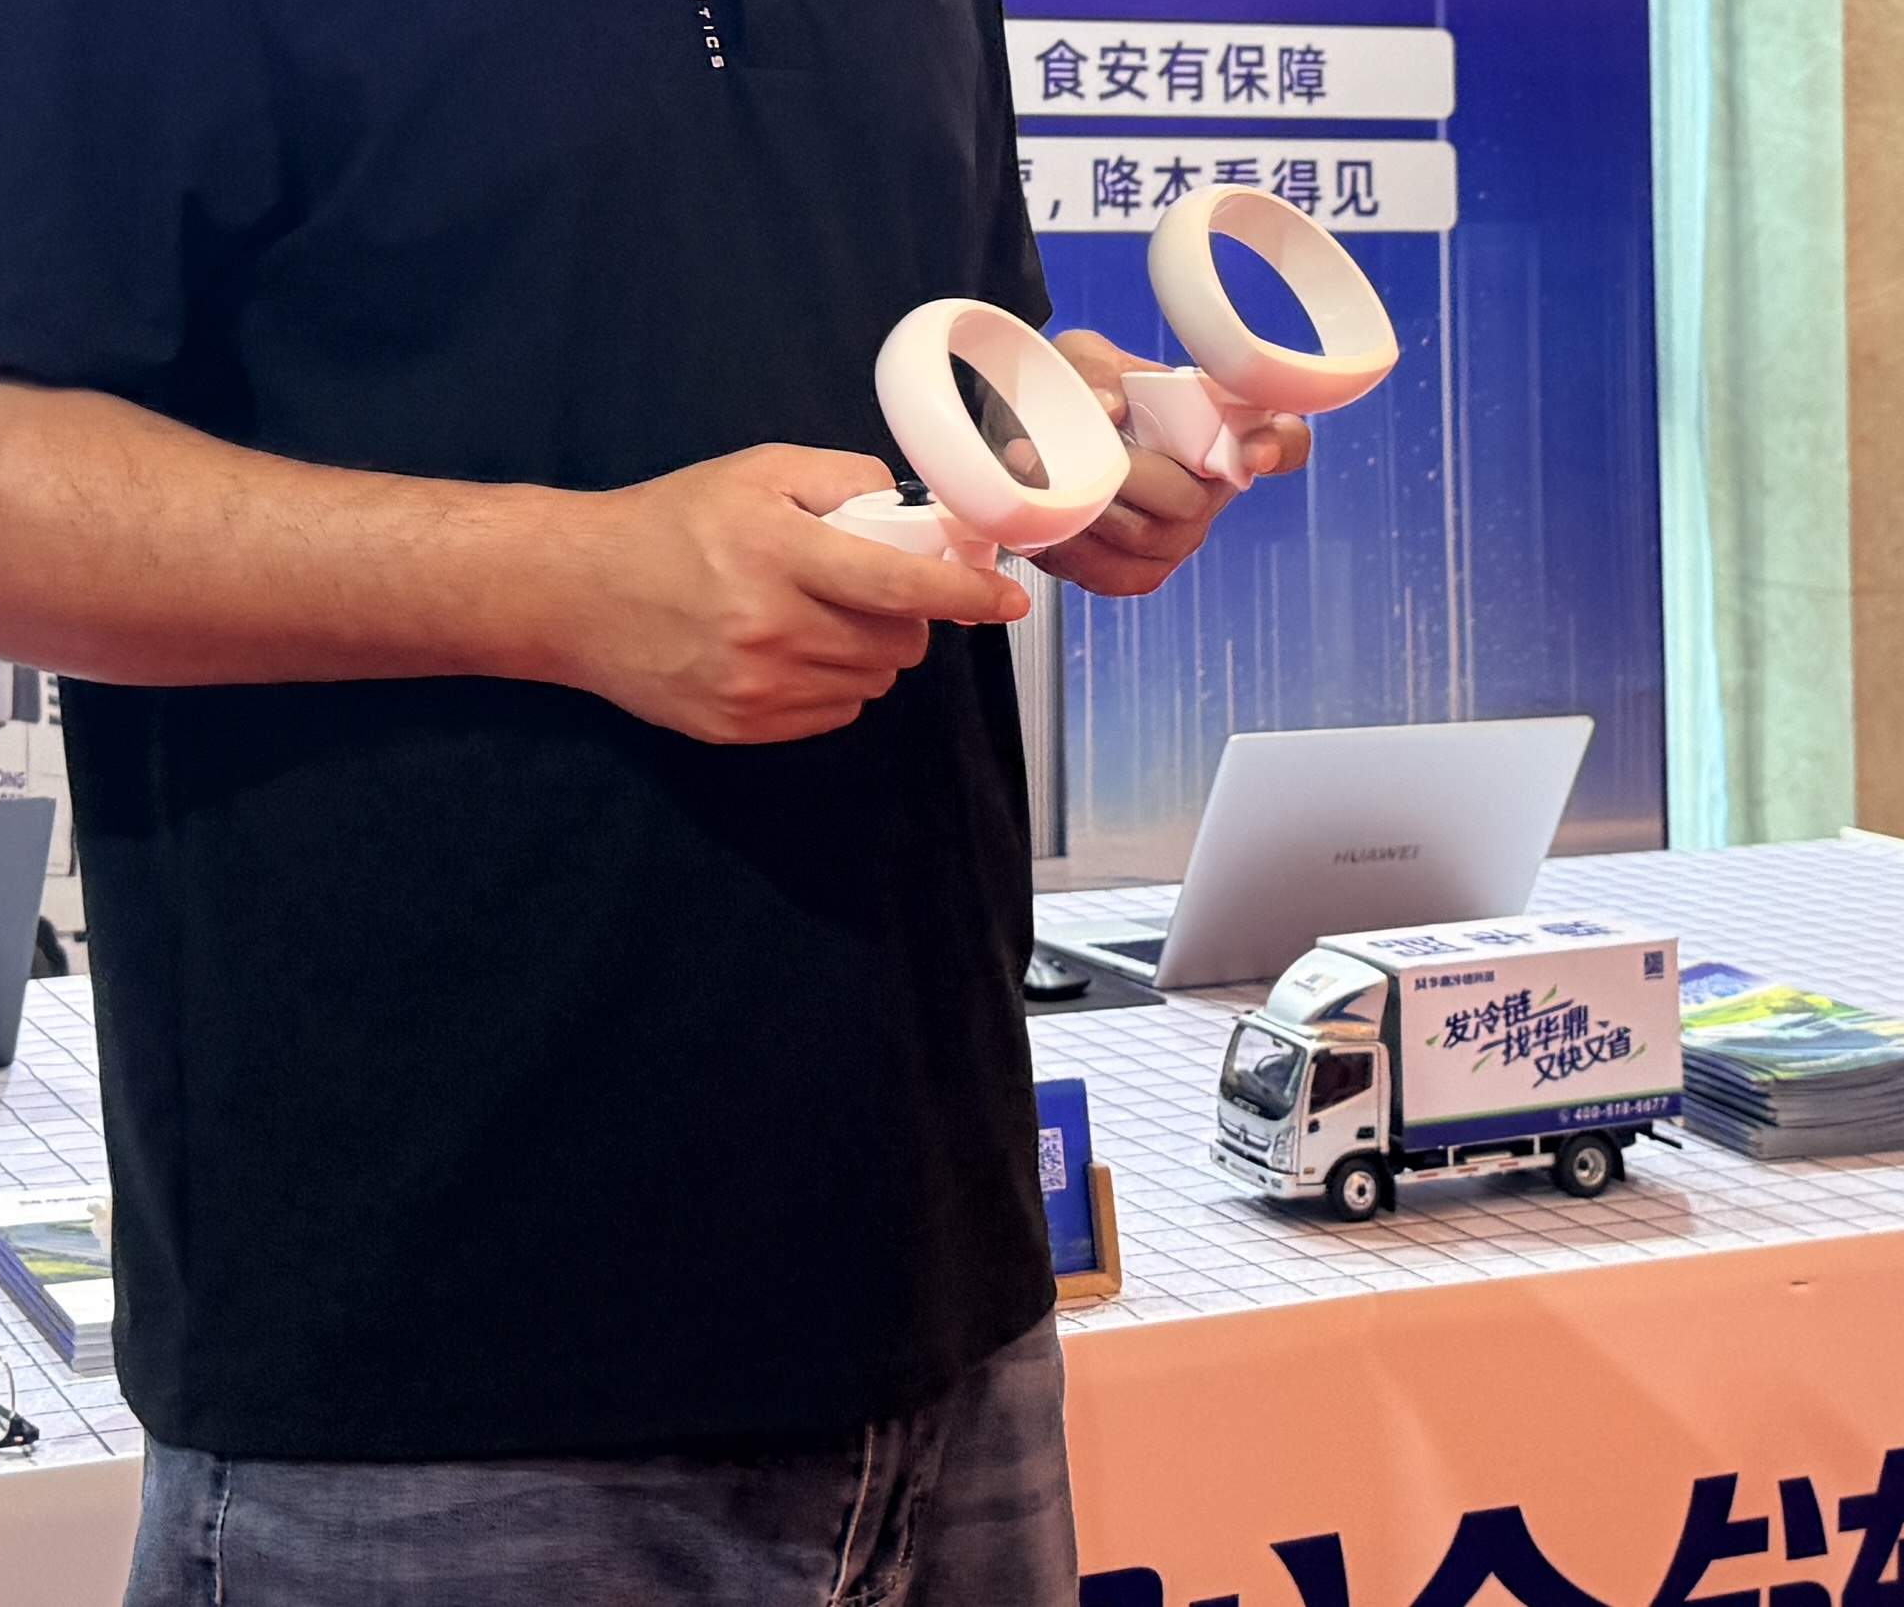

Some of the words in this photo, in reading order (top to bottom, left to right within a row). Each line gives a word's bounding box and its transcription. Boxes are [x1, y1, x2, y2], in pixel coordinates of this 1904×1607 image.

[1034, 38, 1329, 105] 食安有保障
[1333, 843, 1421, 865] HUAWEI
[1443, 989, 1533, 1049] 发冷链
[1480, 1004, 1590, 1066] 找华鼎
[1533, 1027, 1632, 1087] 又快又省
